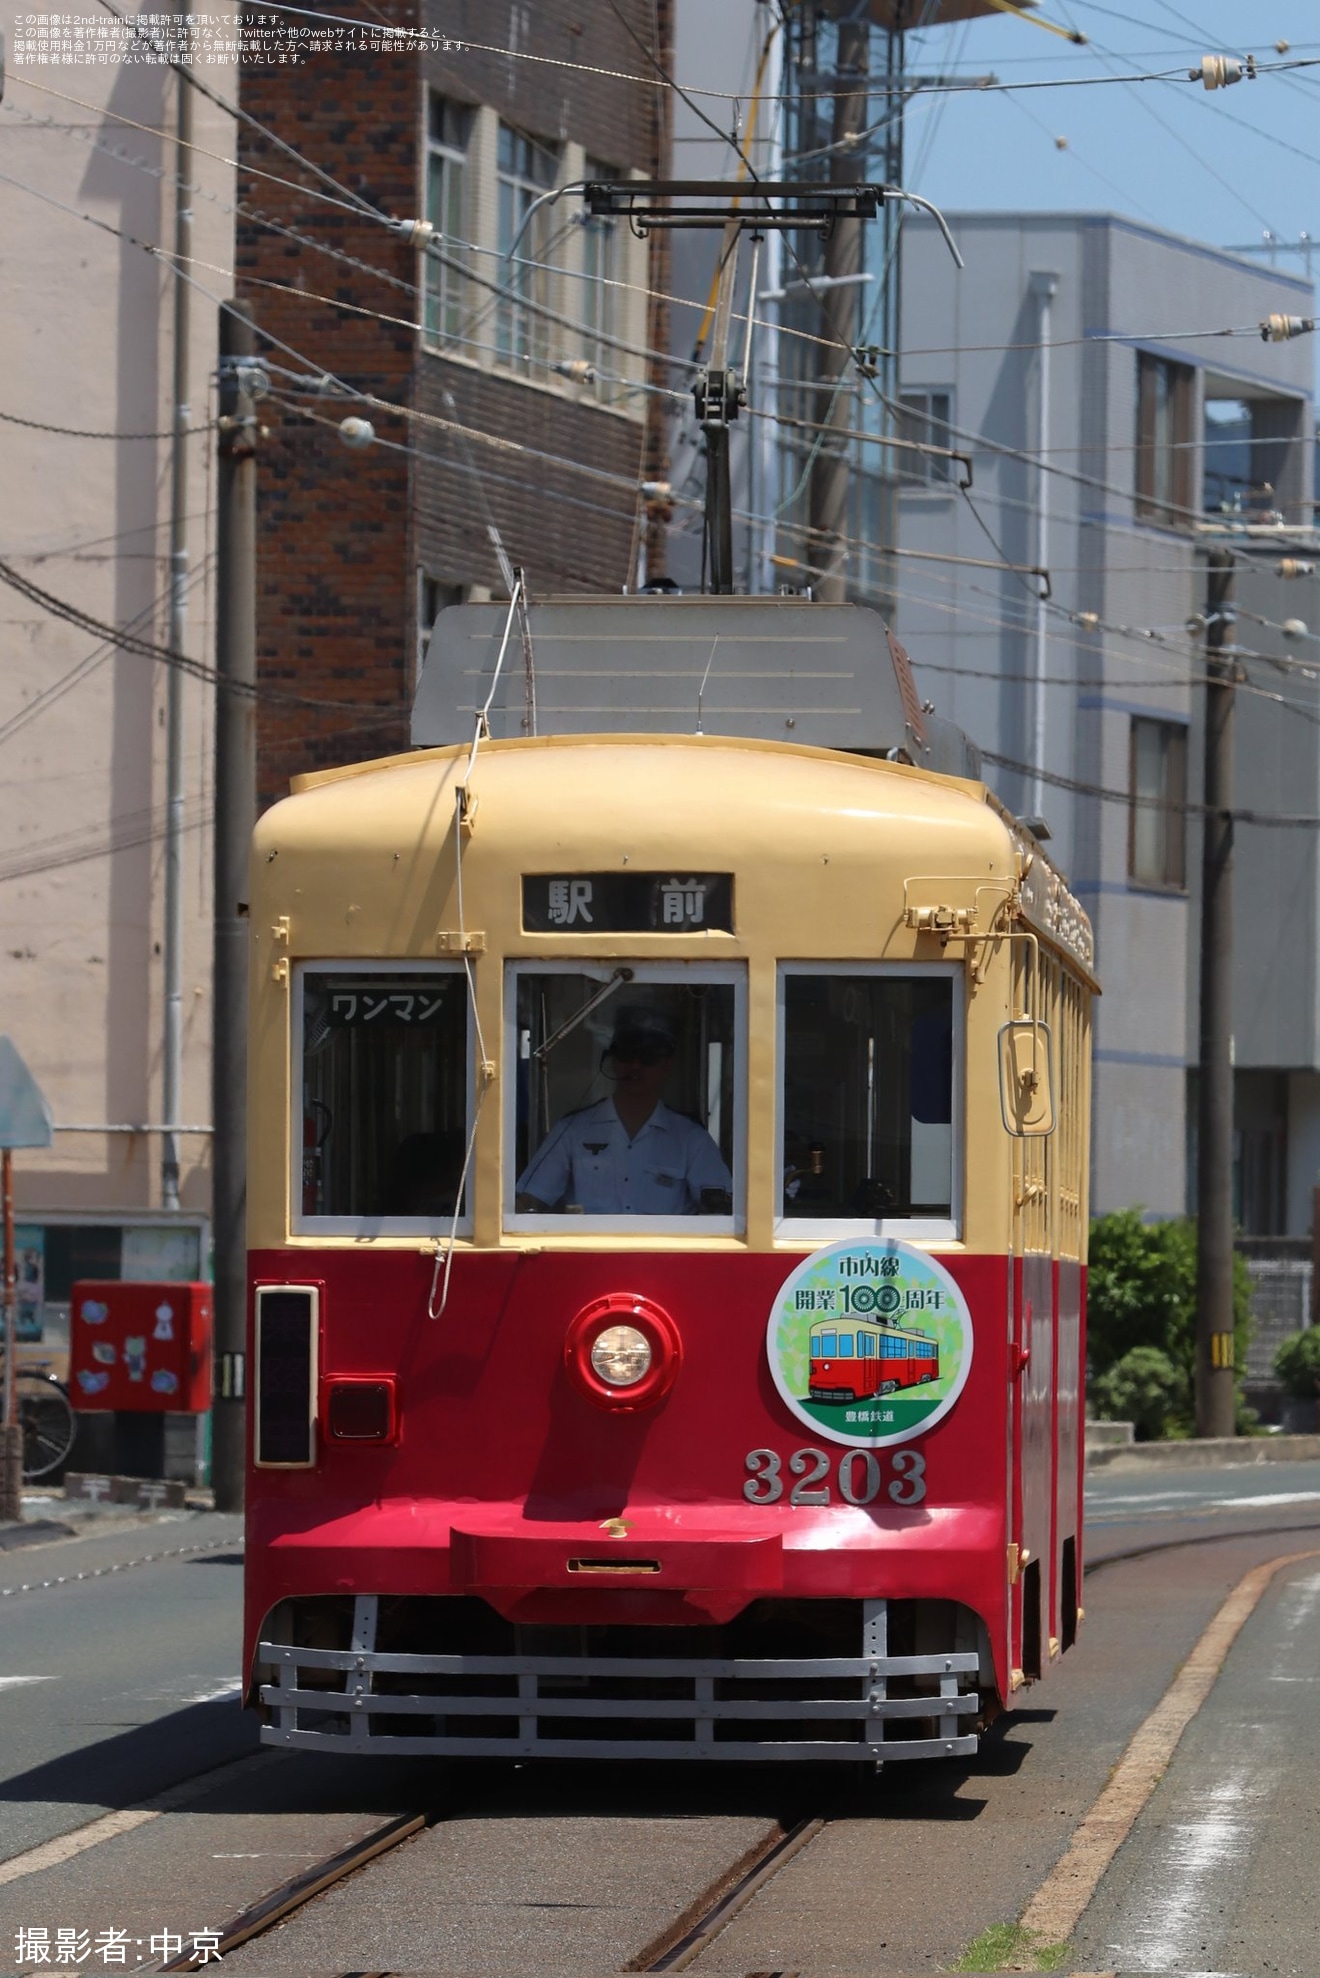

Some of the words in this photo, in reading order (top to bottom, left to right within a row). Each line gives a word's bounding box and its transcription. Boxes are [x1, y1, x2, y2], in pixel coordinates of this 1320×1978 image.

[332, 994, 443, 1022] ワンマン
[839, 1256, 900, 1277] 市内線
[845, 1410, 895, 1422] 豊橋鉄道
[743, 1448, 927, 1505] 3203
